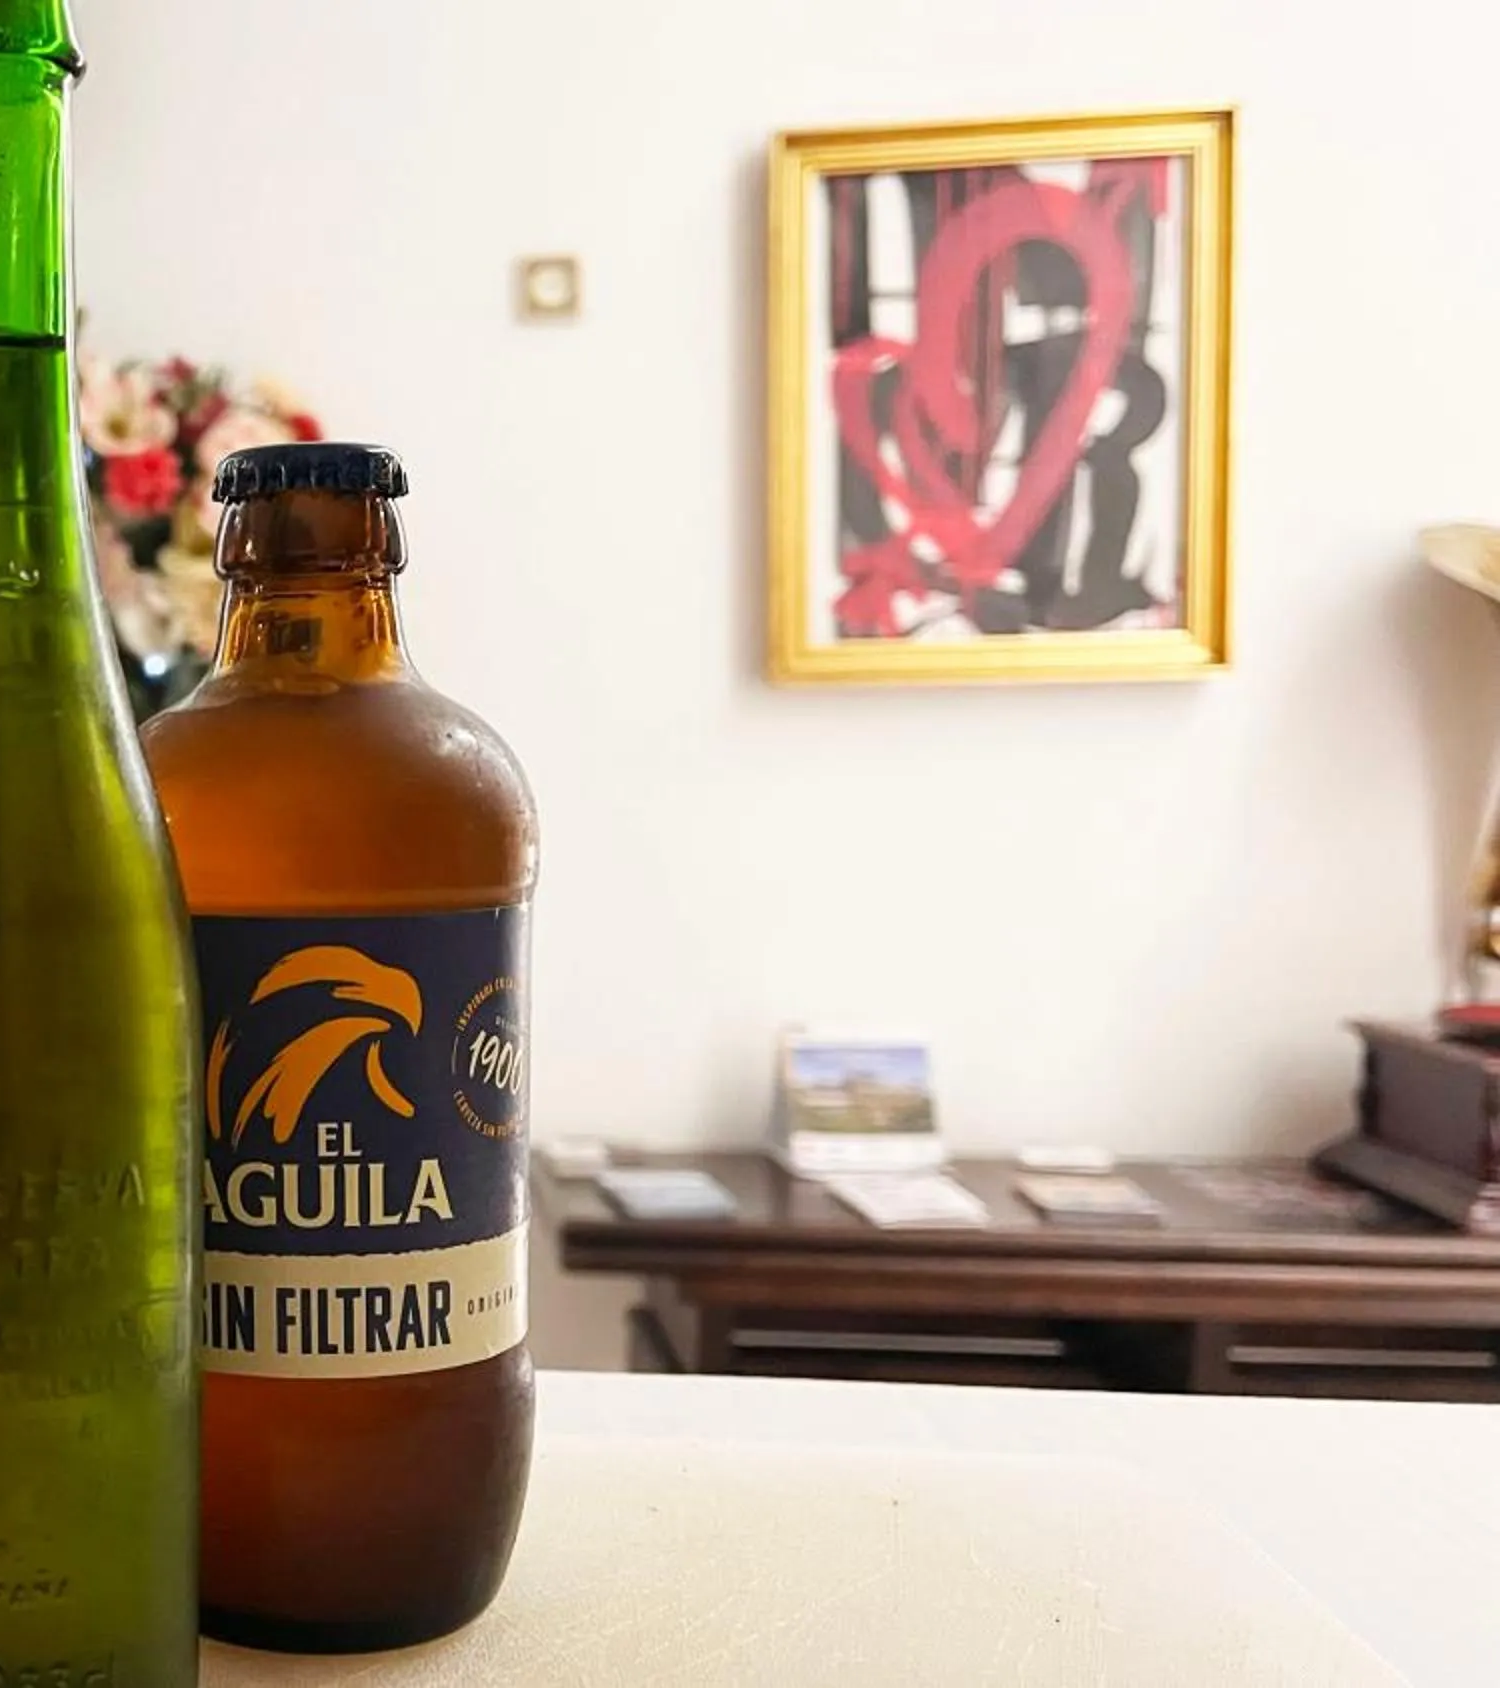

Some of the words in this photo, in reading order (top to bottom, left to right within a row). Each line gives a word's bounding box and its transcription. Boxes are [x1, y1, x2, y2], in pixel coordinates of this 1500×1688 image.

[469, 1029, 524, 1096] 1900
[317, 1122, 364, 1158] EL
[202, 1283, 255, 1353] IN
[275, 1280, 452, 1355] FILTRAR
